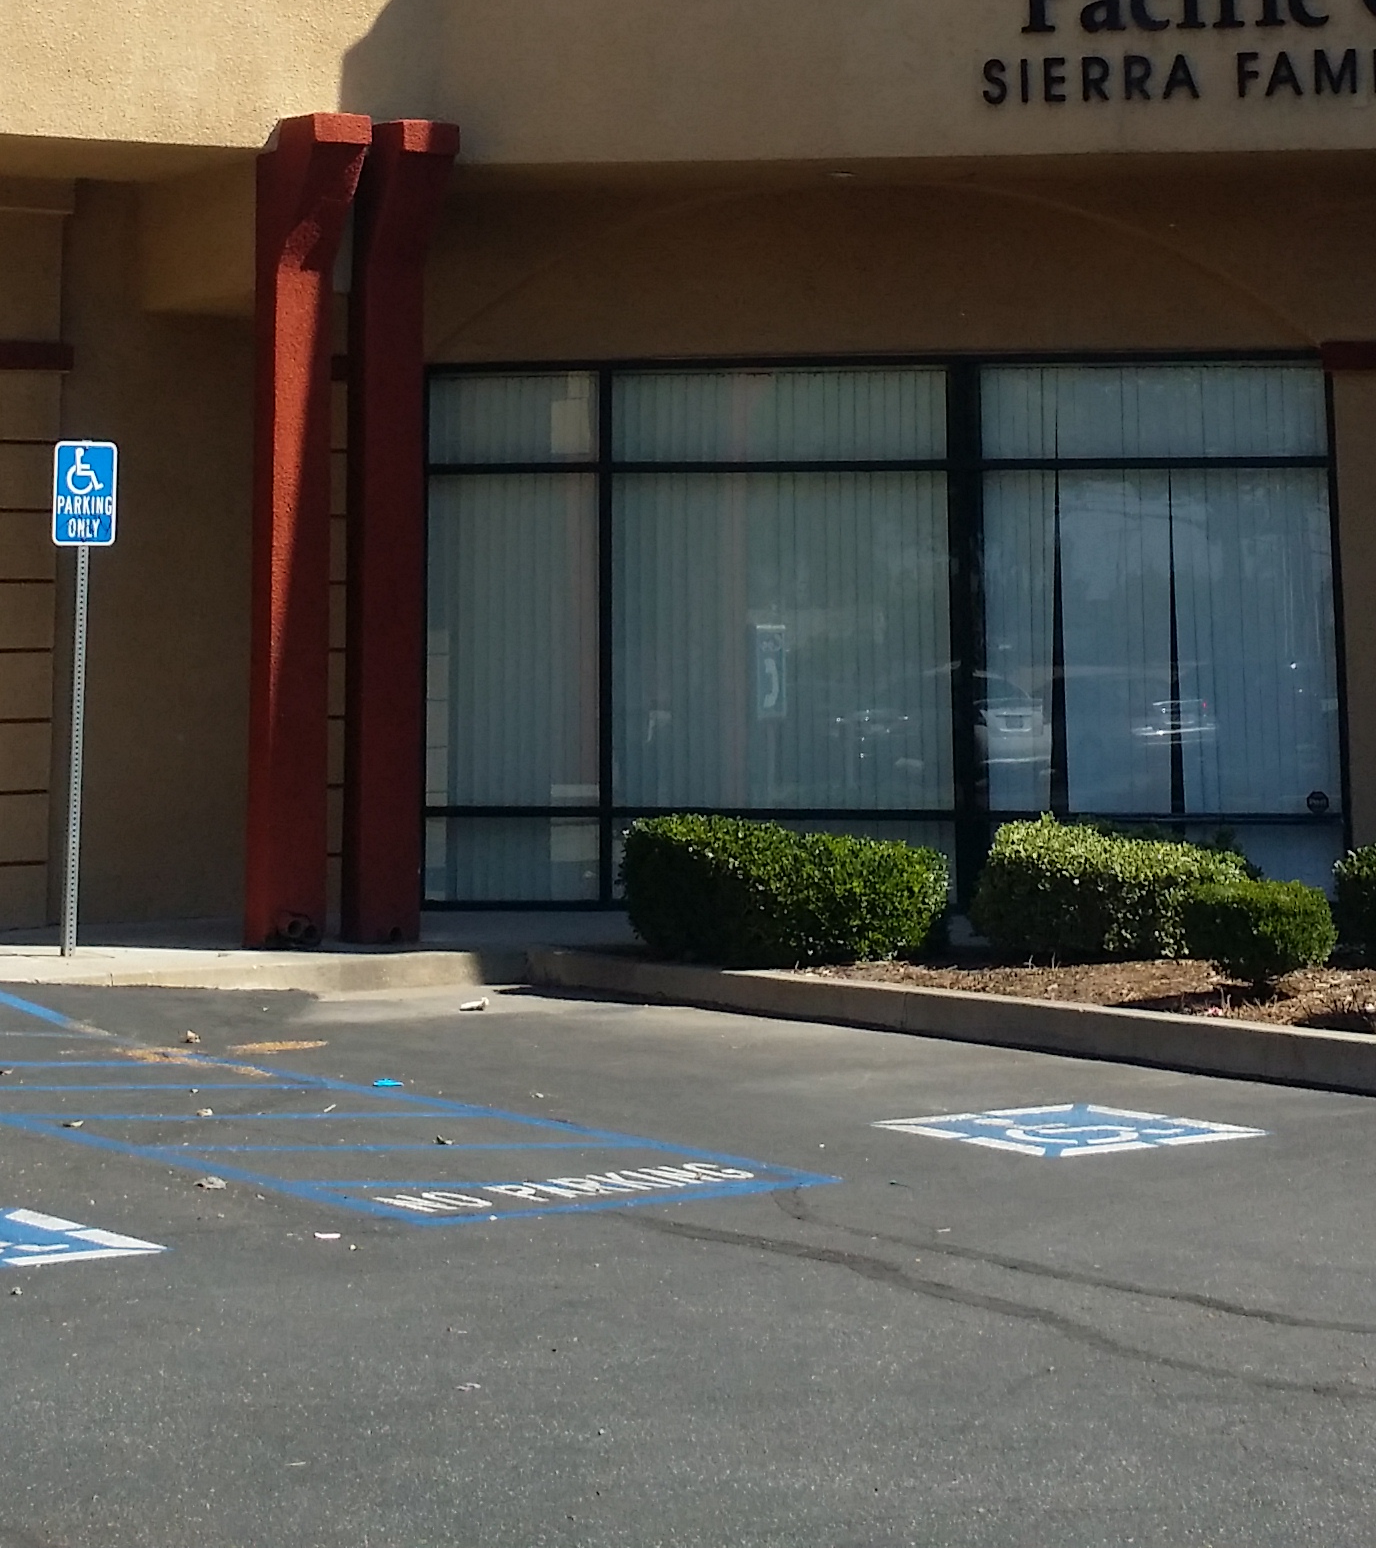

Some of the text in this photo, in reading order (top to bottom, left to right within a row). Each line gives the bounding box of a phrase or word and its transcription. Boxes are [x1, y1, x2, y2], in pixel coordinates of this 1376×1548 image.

[981, 54, 1200, 107] SIERRA
[56, 495, 113, 516] PARKING
[67, 518, 101, 539] ONLY
[372, 1161, 756, 1213] NO PARKING
